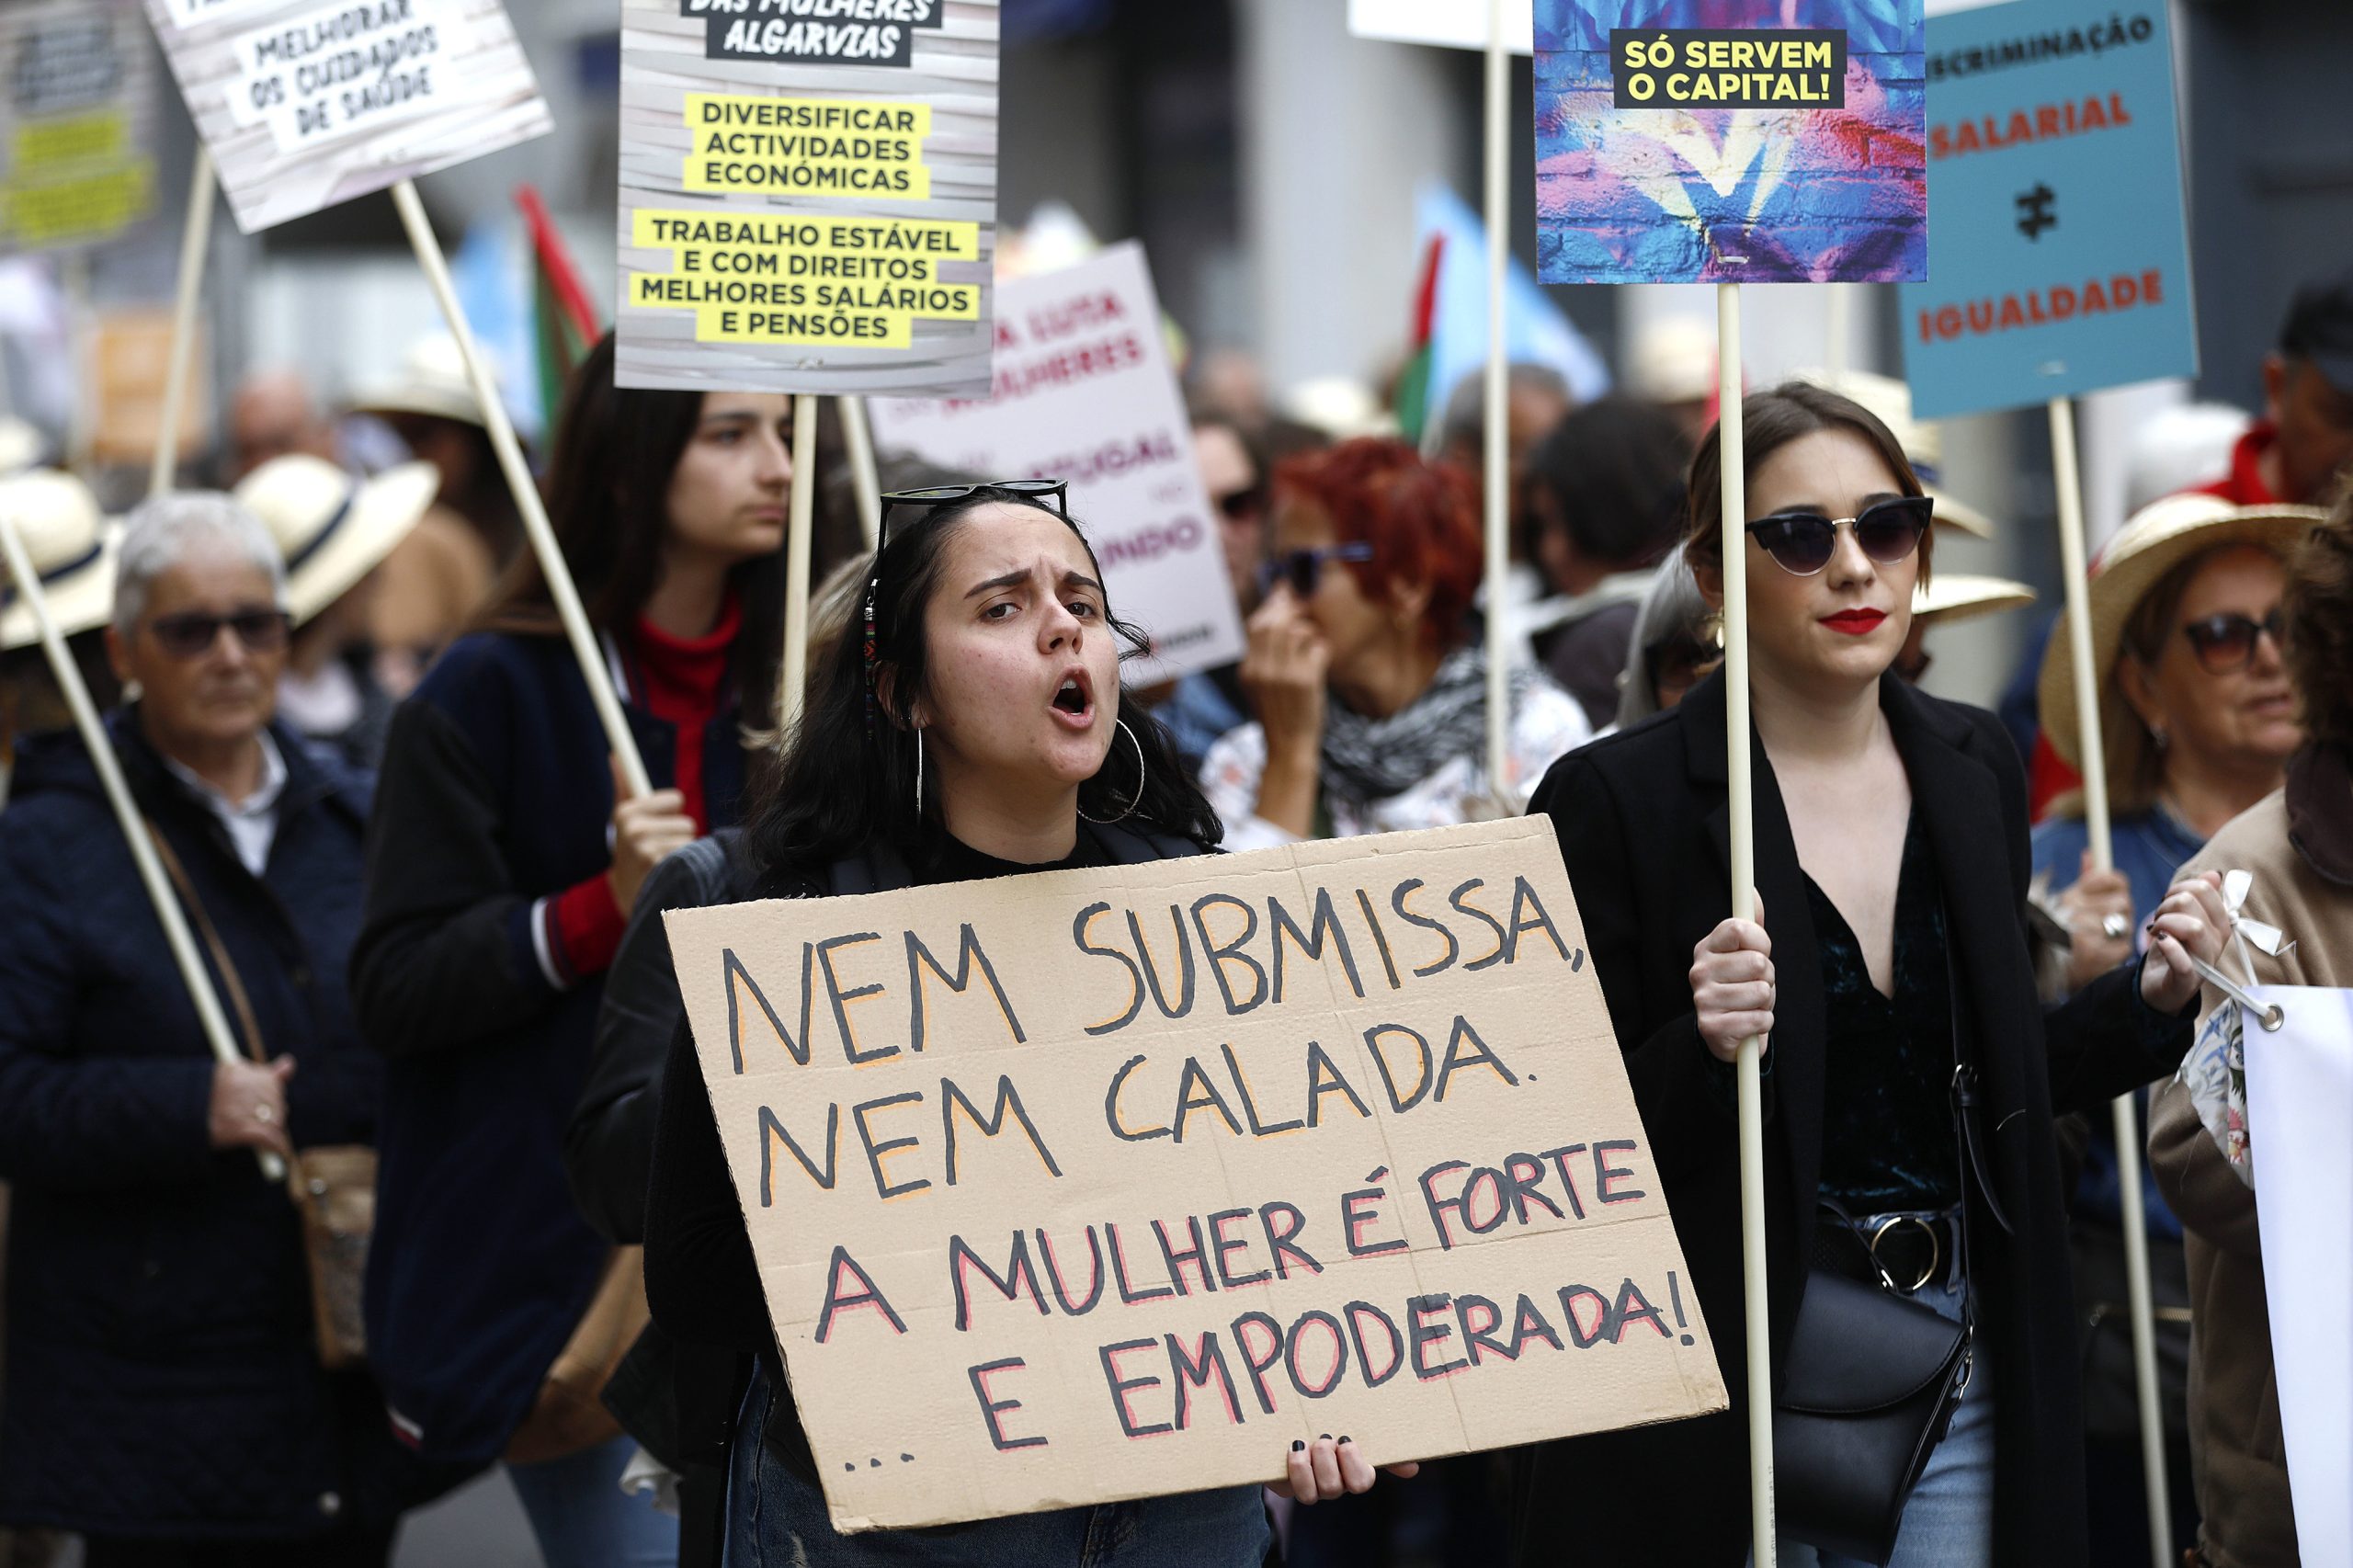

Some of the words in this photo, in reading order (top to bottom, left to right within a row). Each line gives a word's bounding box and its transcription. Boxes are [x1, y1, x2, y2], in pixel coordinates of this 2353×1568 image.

[256, 0, 413, 67] MELHORAR
[723, 18, 901, 59] ALGARVIAS
[1625, 33, 1675, 69] SÓ
[1686, 41, 1831, 69] SERVEM
[1926, 11, 2154, 85] SCRIMINAÇÃO
[250, 77, 285, 108] OS
[297, 26, 438, 96] CUIDADOS
[1629, 74, 1656, 100] O
[1667, 74, 1830, 100] CAPITAL!
[297, 101, 330, 136] DE
[341, 65, 432, 120] SAÚDE
[703, 103, 914, 131] DIVERSIFICAR
[1930, 90, 2131, 161] SALARIAL
[707, 133, 909, 160] ACTIVIDADES
[706, 160, 909, 190] ECONÓMICAS
[653, 220, 819, 246] TRABALHO
[831, 223, 960, 252] ESTÁVEL
[684, 252, 700, 271] E
[711, 253, 777, 274] COM
[790, 256, 927, 279] DIREITOS
[642, 279, 805, 305] MELHORES
[817, 283, 968, 311] SALÁRIOS
[1919, 269, 2162, 344] IGUALDADE
[722, 312, 737, 332] E
[749, 310, 888, 338] PENSÕES
[722, 922, 1027, 1074] NEM
[1074, 876, 1584, 1036] SUBMISSA,
[758, 1074, 1063, 1208] NEM
[1106, 1016, 1538, 1142] CALADA.
[815, 1246, 907, 1343] A
[949, 1202, 1324, 1332] MULHER
[1342, 1166, 1408, 1256] É
[1418, 1141, 1646, 1251] FORTE
[968, 1358, 1048, 1450] E
[1099, 1271, 1696, 1439] EMPODERADA!
